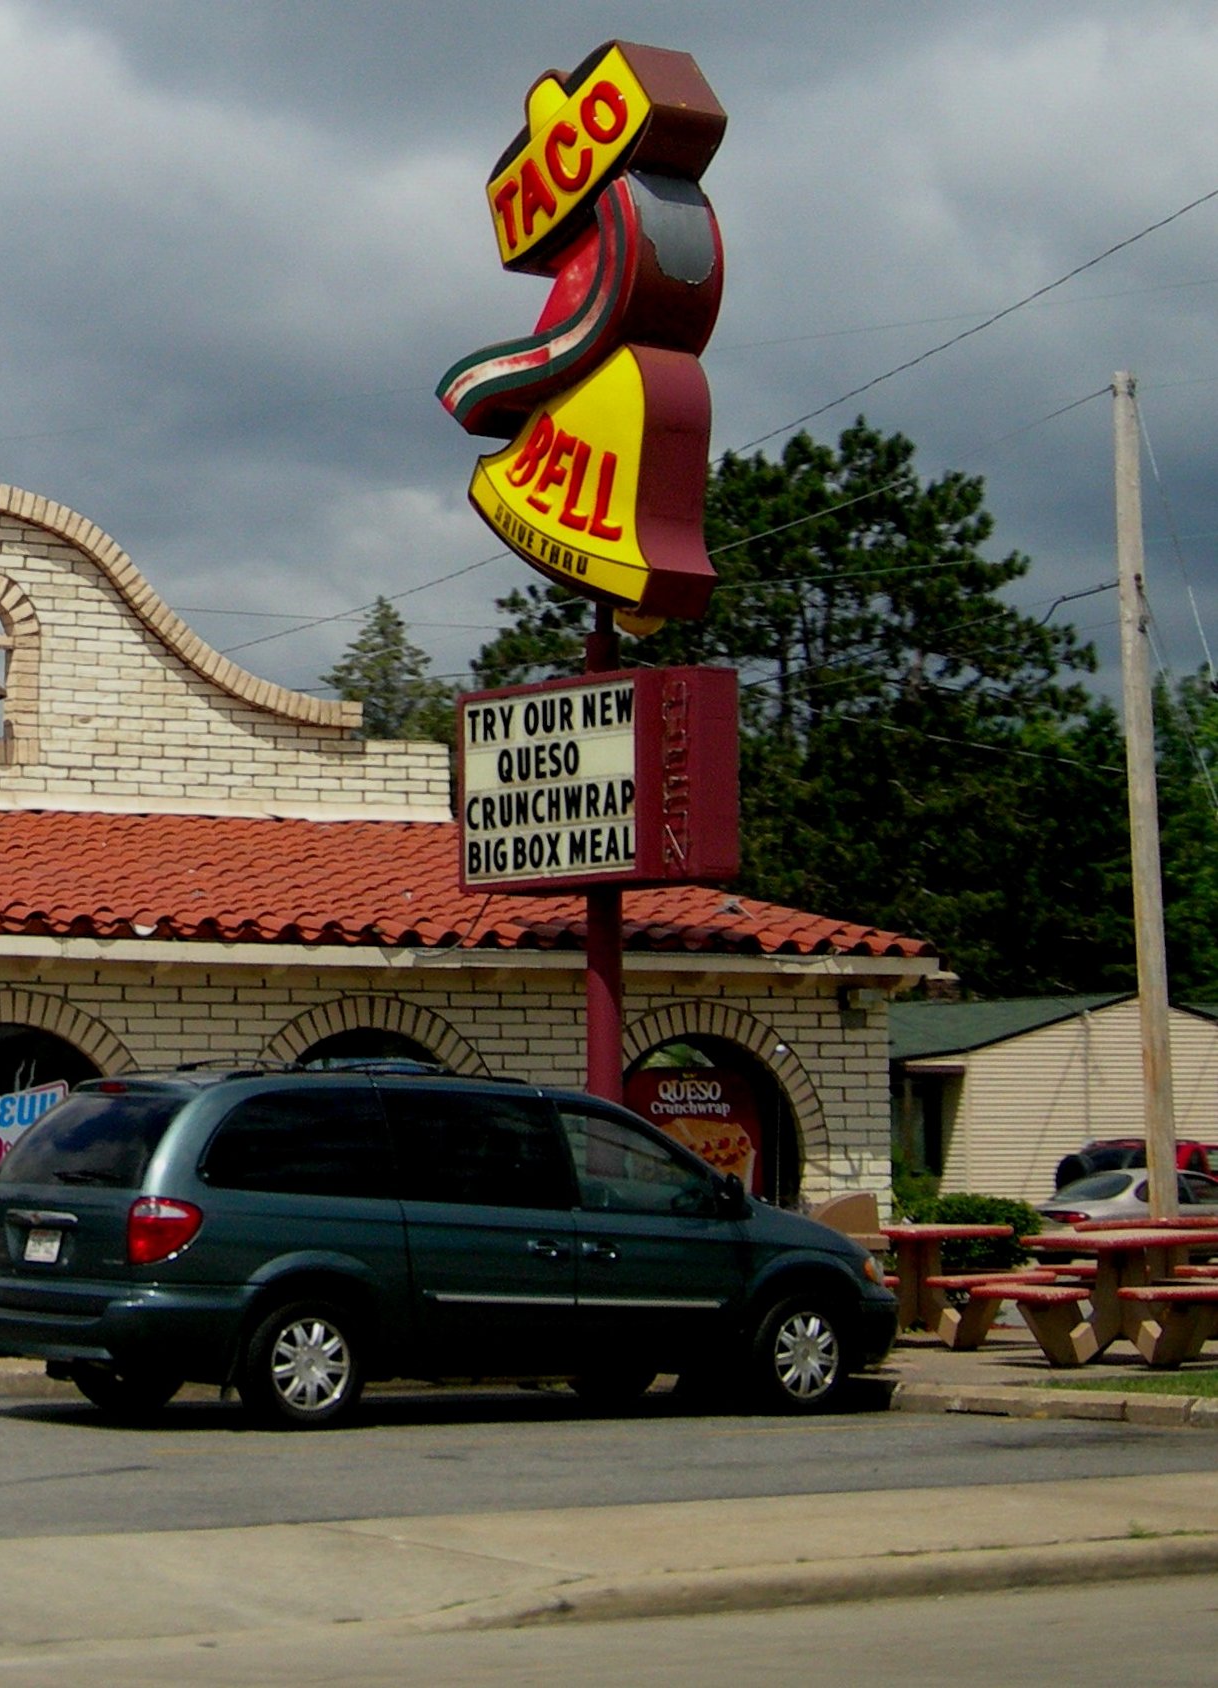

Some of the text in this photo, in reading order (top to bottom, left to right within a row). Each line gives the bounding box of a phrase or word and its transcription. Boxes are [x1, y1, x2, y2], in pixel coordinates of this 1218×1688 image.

[494, 80, 629, 250] TACO
[504, 413, 622, 542] BELL
[494, 503, 588, 575] DRIVE THRU
[468, 688, 634, 743] TRY OUR NEW
[497, 740, 580, 783] QUESO
[466, 779, 635, 831] CRUNCHWRAP
[468, 825, 635, 874] BIG BOX MEAL
[650, 1101, 730, 1117] Crunchwrap
[658, 1080, 722, 1102] QUESO
